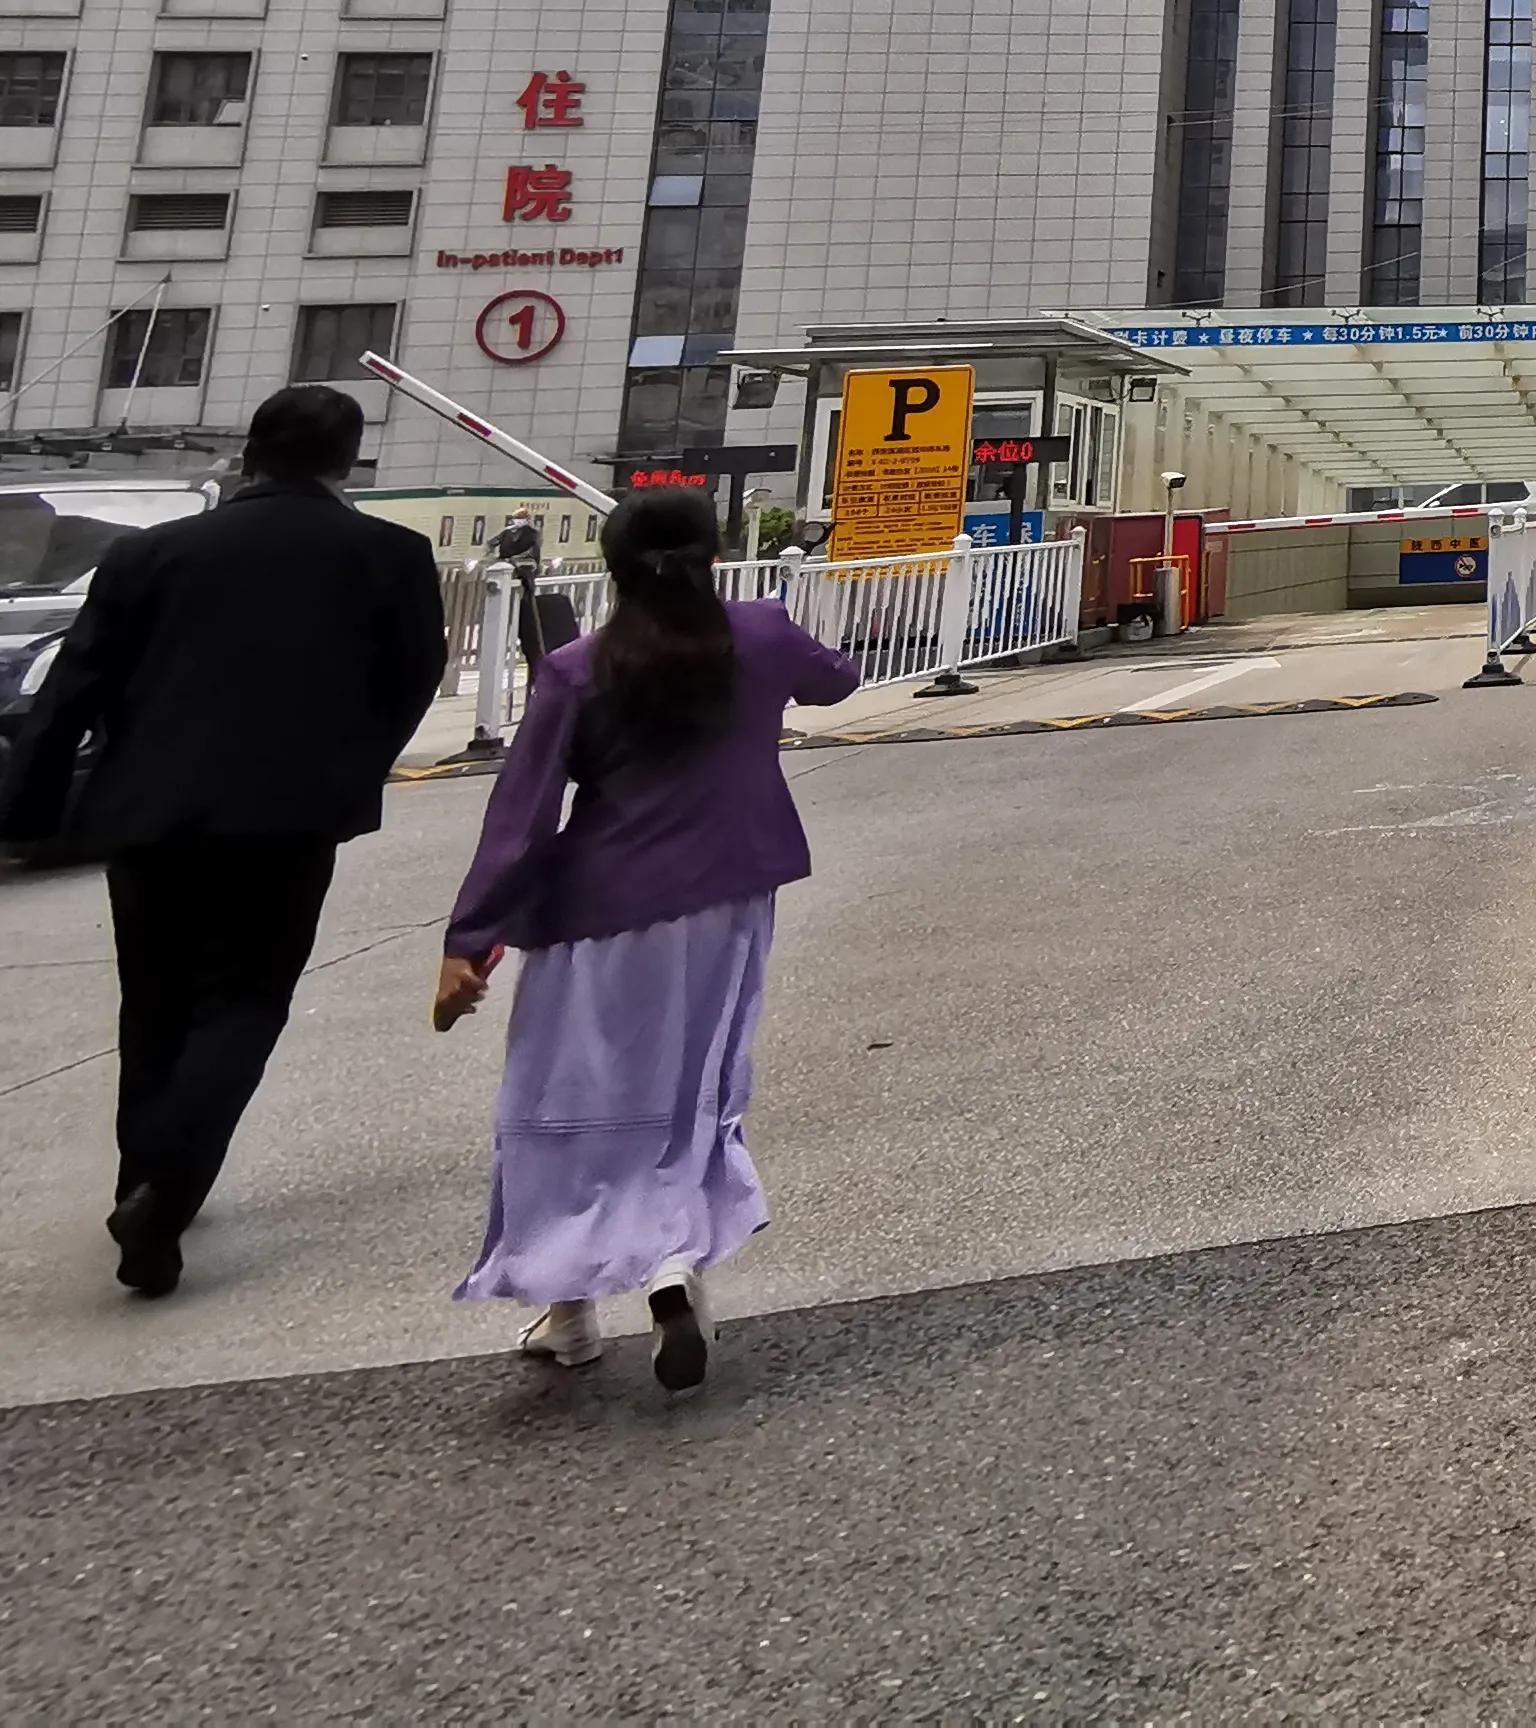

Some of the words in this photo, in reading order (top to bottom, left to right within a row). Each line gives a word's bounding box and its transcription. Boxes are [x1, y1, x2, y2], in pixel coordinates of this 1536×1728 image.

[502, 69, 587, 223] 住院
[436, 248, 555, 271] In-patient
[882, 376, 941, 442] P
[974, 440, 1034, 463] 余位0
